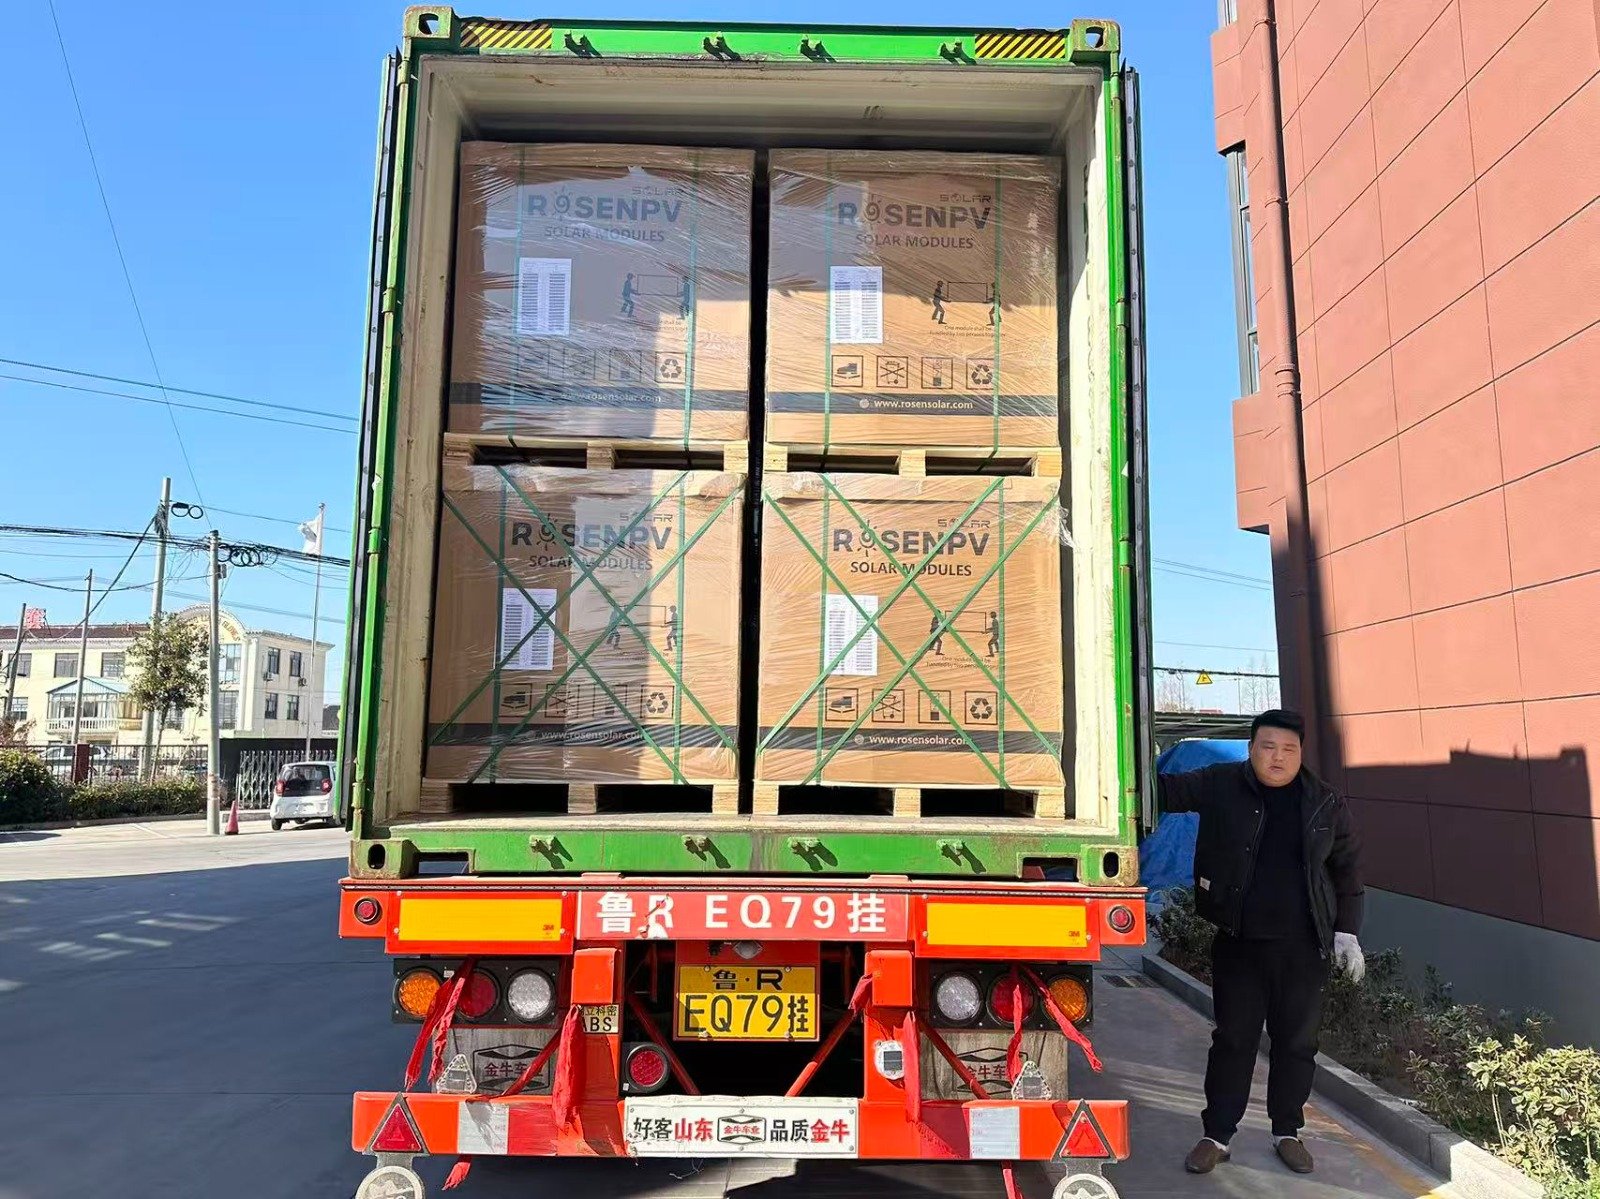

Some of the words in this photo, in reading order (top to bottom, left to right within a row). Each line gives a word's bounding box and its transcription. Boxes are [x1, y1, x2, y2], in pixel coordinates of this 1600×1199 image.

[856, 234, 900, 247] SOLAR
[905, 235, 974, 249] MODULES
[874, 399, 973, 409] www.rosensolar.com
[850, 561, 898, 574] SOLAR
[684, 994, 809, 1032] EQ79挂
[484, 1062, 544, 1078] 金牛车
[633, 1117, 713, 1142] 好客山东
[723, 1125, 761, 1135] 金牛车业
[770, 1119, 850, 1143] 品质金牛
